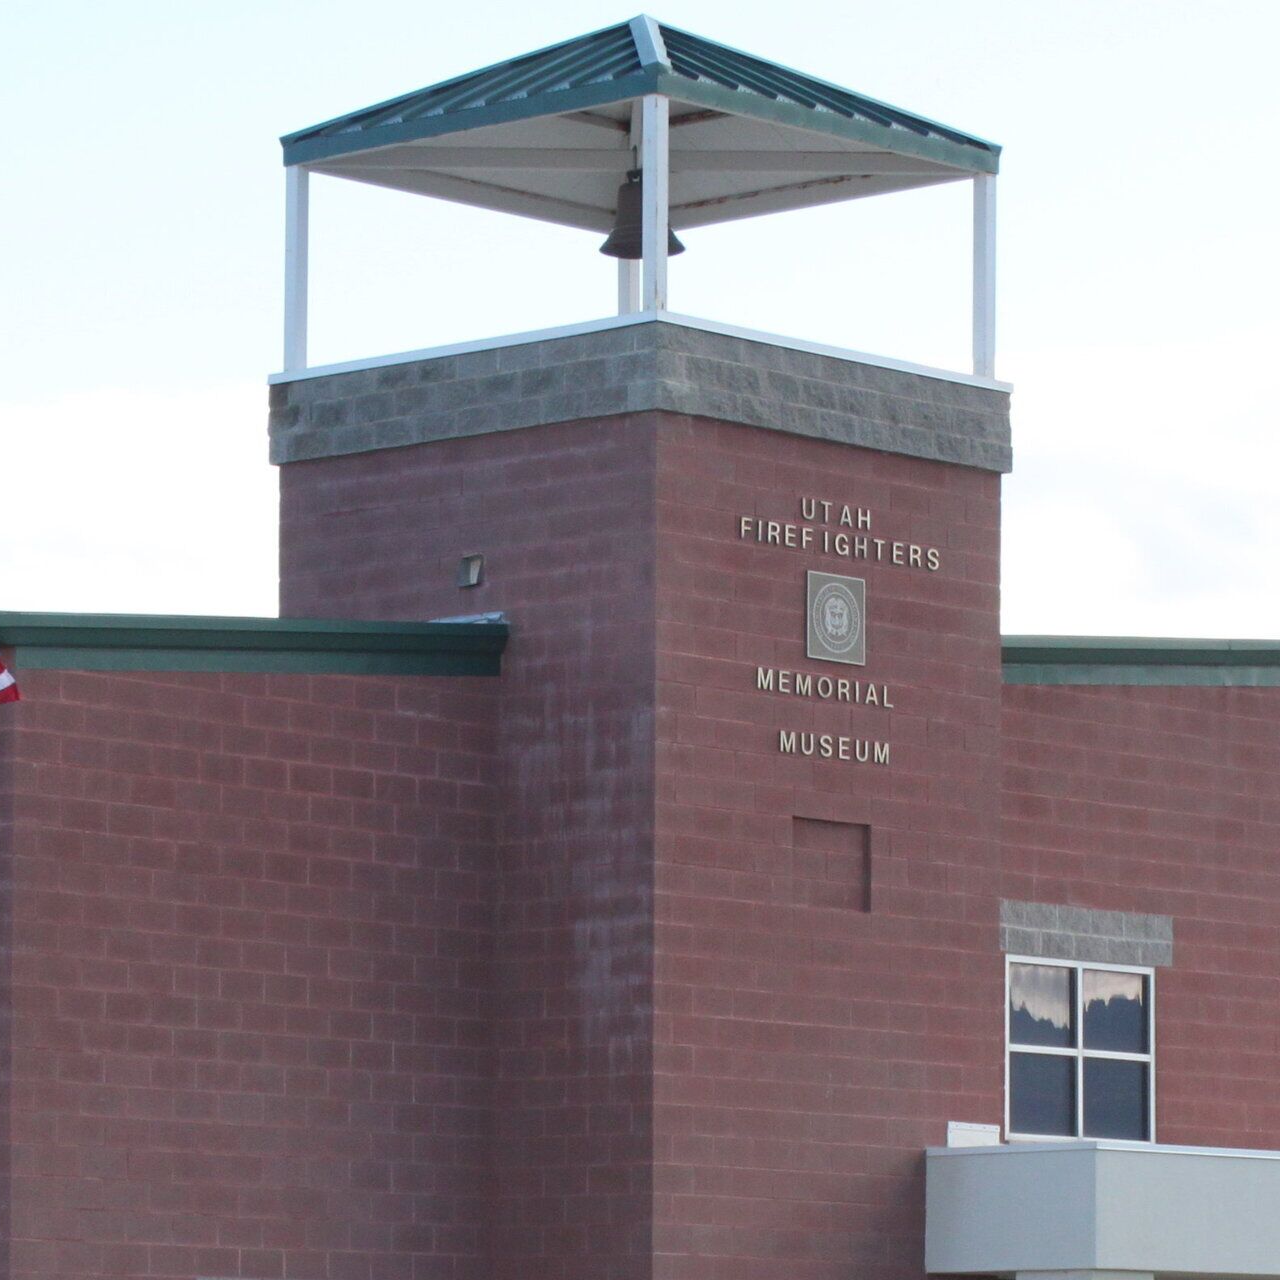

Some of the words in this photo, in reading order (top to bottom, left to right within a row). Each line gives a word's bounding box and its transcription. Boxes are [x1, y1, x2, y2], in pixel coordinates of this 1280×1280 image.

[802, 497, 872, 531] UTAH
[740, 516, 940, 571] FIREFIGHTERS
[756, 667, 895, 709] MEMORIAL
[779, 730, 891, 765] MUSEUM
